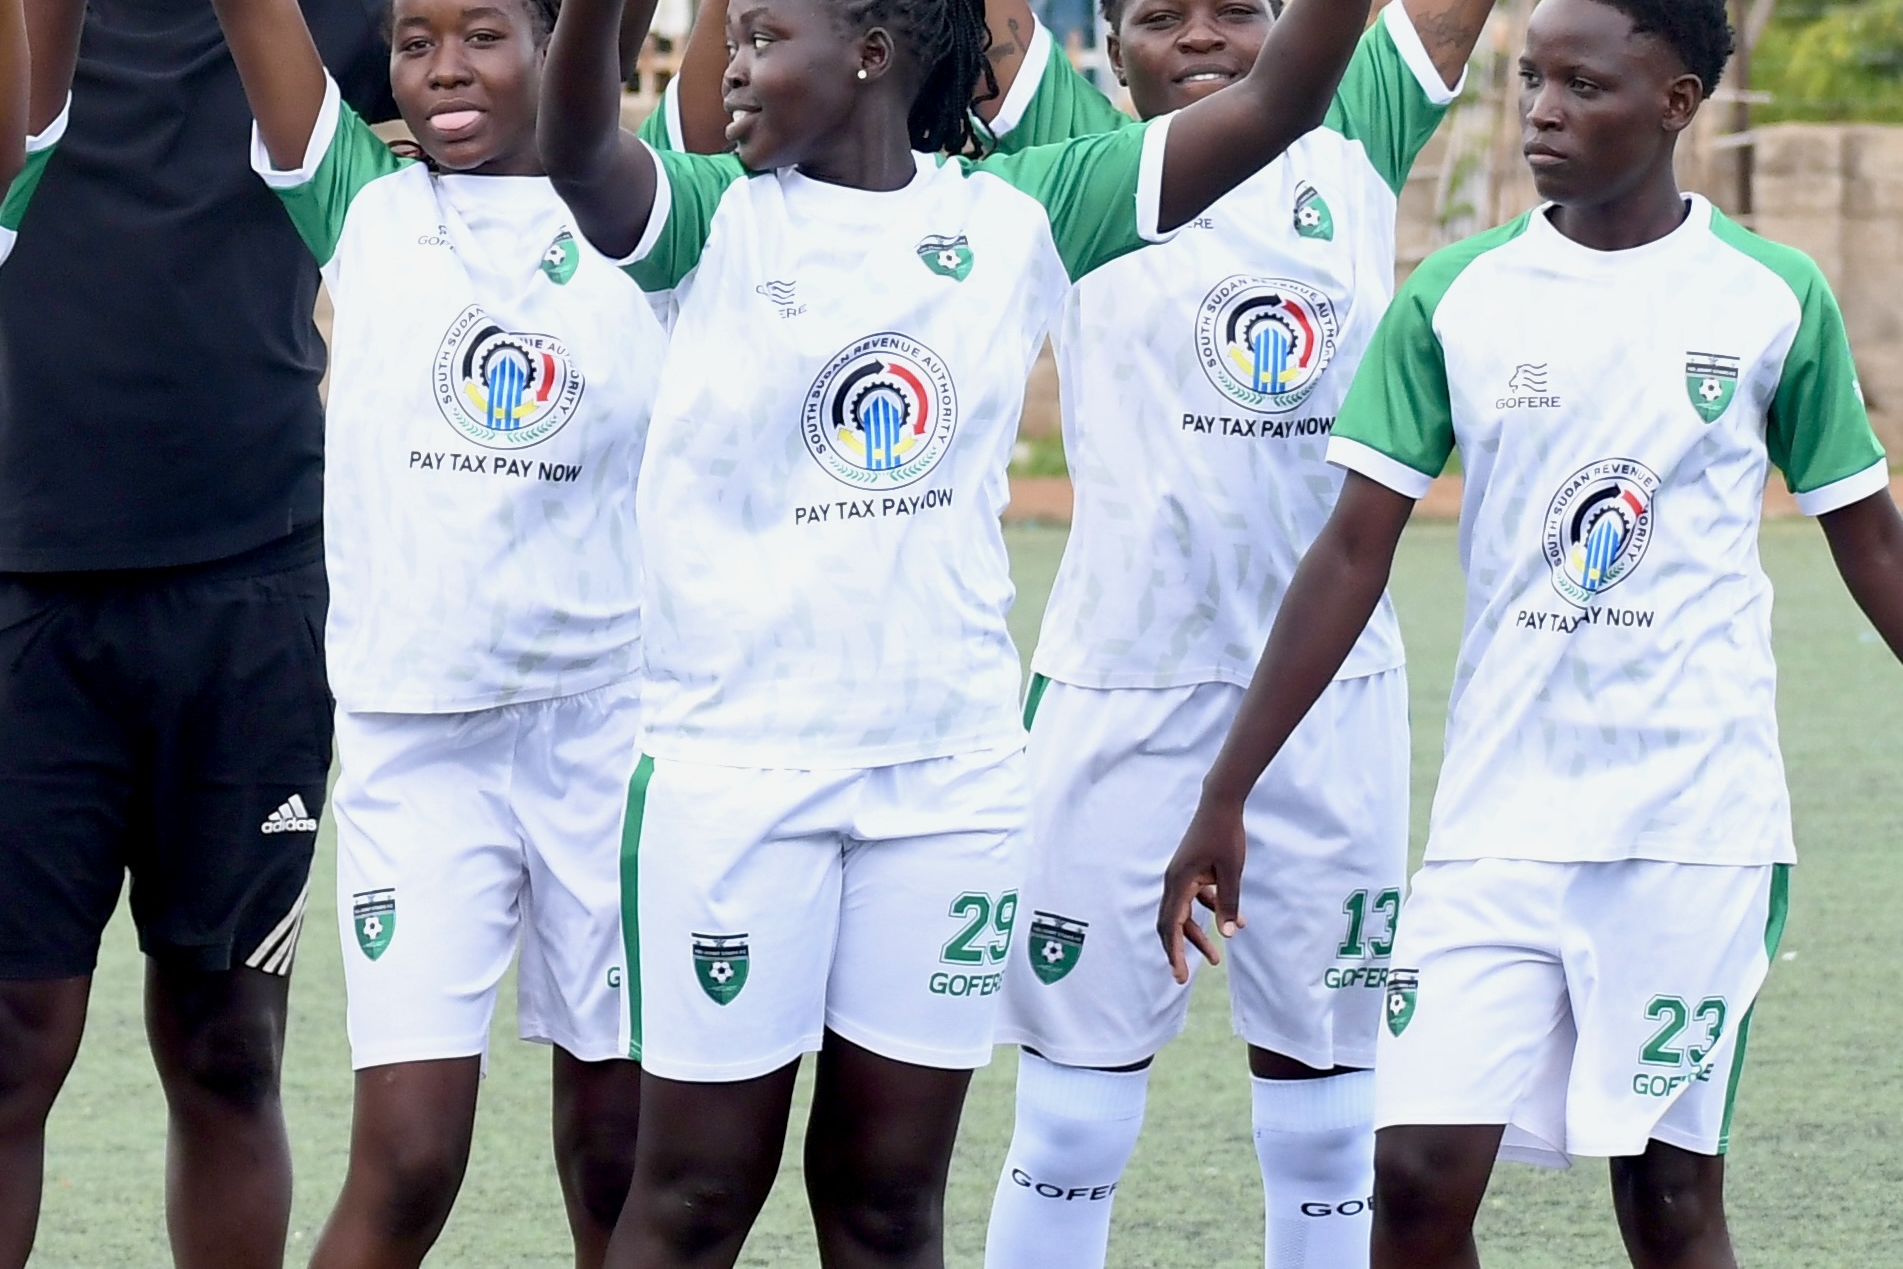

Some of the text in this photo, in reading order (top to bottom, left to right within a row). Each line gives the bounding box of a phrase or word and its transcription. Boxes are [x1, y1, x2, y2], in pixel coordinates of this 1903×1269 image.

[1207, 278, 1248, 313] SUDAN
[1200, 316, 1217, 368] SOUTH
[438, 351, 453, 405] SOUTH
[805, 336, 951, 455] SOUTH SUDAN REVENUE AUTHORITY
[1495, 396, 1562, 410] GOFERE
[1182, 413, 1336, 438] PAY TAX PAY NOW
[409, 450, 583, 483] PAY TAX PAY NOW
[795, 503, 831, 525] PAY
[835, 498, 876, 519] TAX
[882, 495, 921, 517] PAY
[1553, 472, 1591, 516] SUDAN
[1547, 520, 1563, 568] SOUTH
[1516, 610, 1548, 628] PAY
[1607, 608, 1655, 628] NOW
[261, 817, 317, 834] adidas
[939, 888, 1018, 967] 29
[1336, 887, 1400, 960] 13
[1638, 994, 1728, 1068] 23
